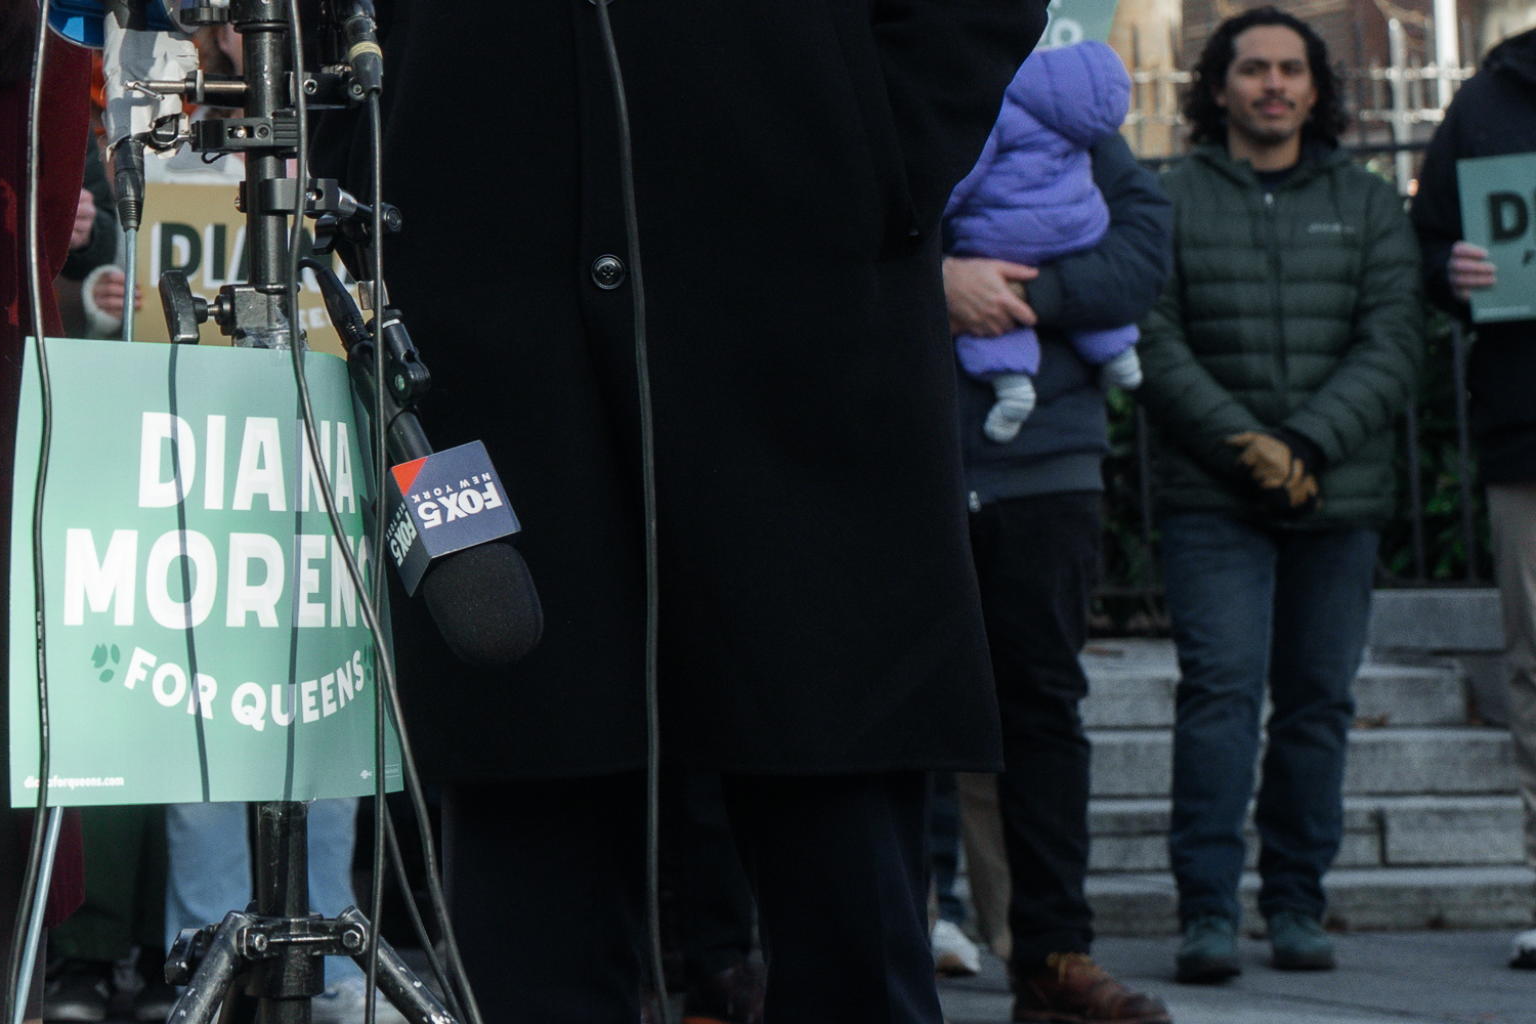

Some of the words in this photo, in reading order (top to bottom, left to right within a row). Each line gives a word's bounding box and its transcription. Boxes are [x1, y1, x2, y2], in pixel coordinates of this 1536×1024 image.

[137, 411, 357, 514] DIANA
[459, 472, 492, 489] NEW
[411, 484, 453, 504] YORK
[124, 646, 218, 720] FOR
[230, 650, 366, 732] QUEENS
